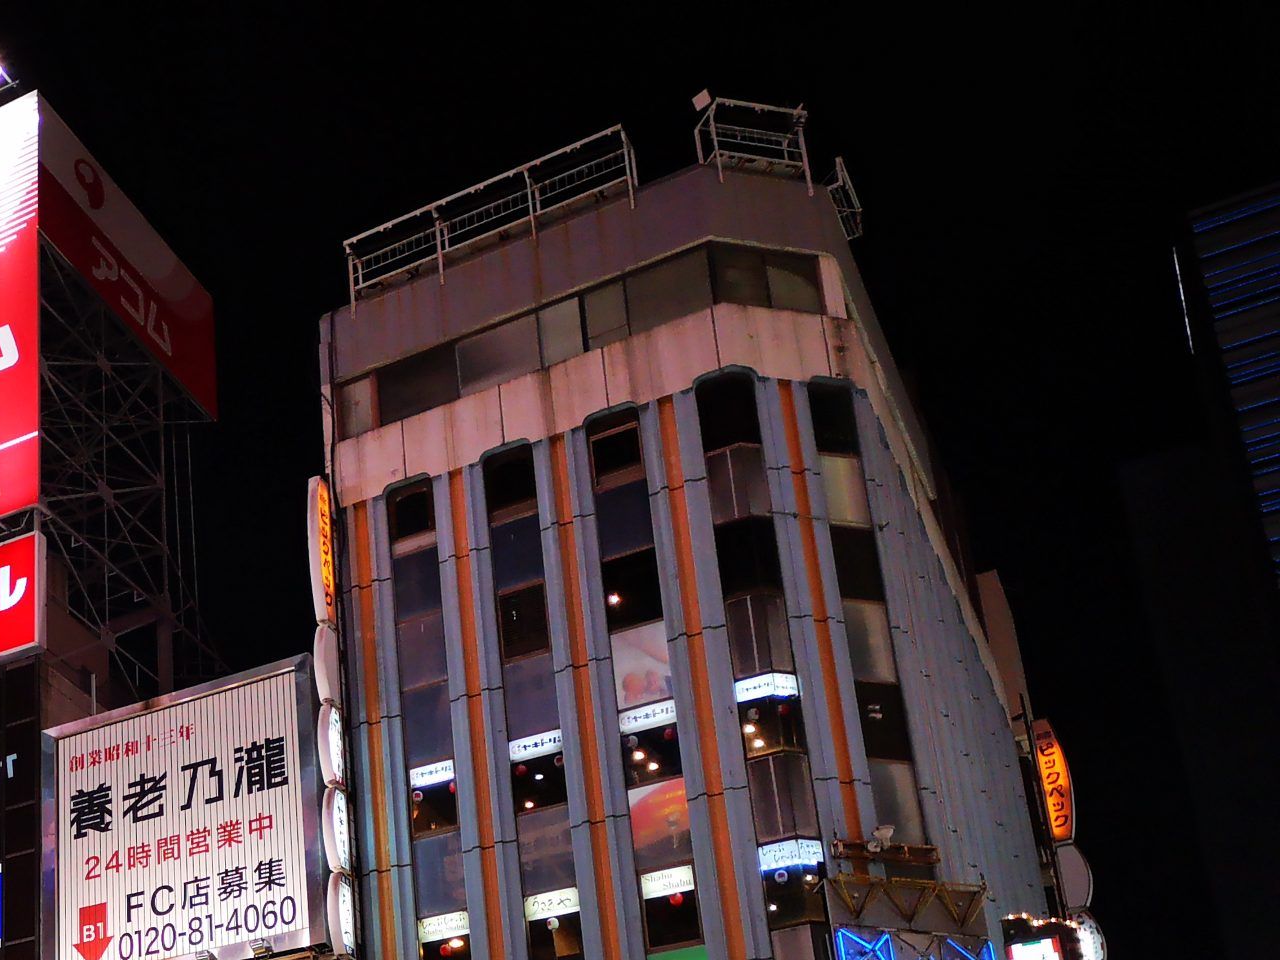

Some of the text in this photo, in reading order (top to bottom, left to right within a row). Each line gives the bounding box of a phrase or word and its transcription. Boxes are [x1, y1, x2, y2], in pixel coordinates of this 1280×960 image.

[70, 723, 195, 772] 創業昭和十三年
[70, 736, 289, 840] 養老乃瀧
[85, 812, 273, 880] 24時間営業中
[126, 858, 286, 923] FC店募集
[83, 922, 105, 943] B1
[118, 895, 297, 960] 0120-81-4060
